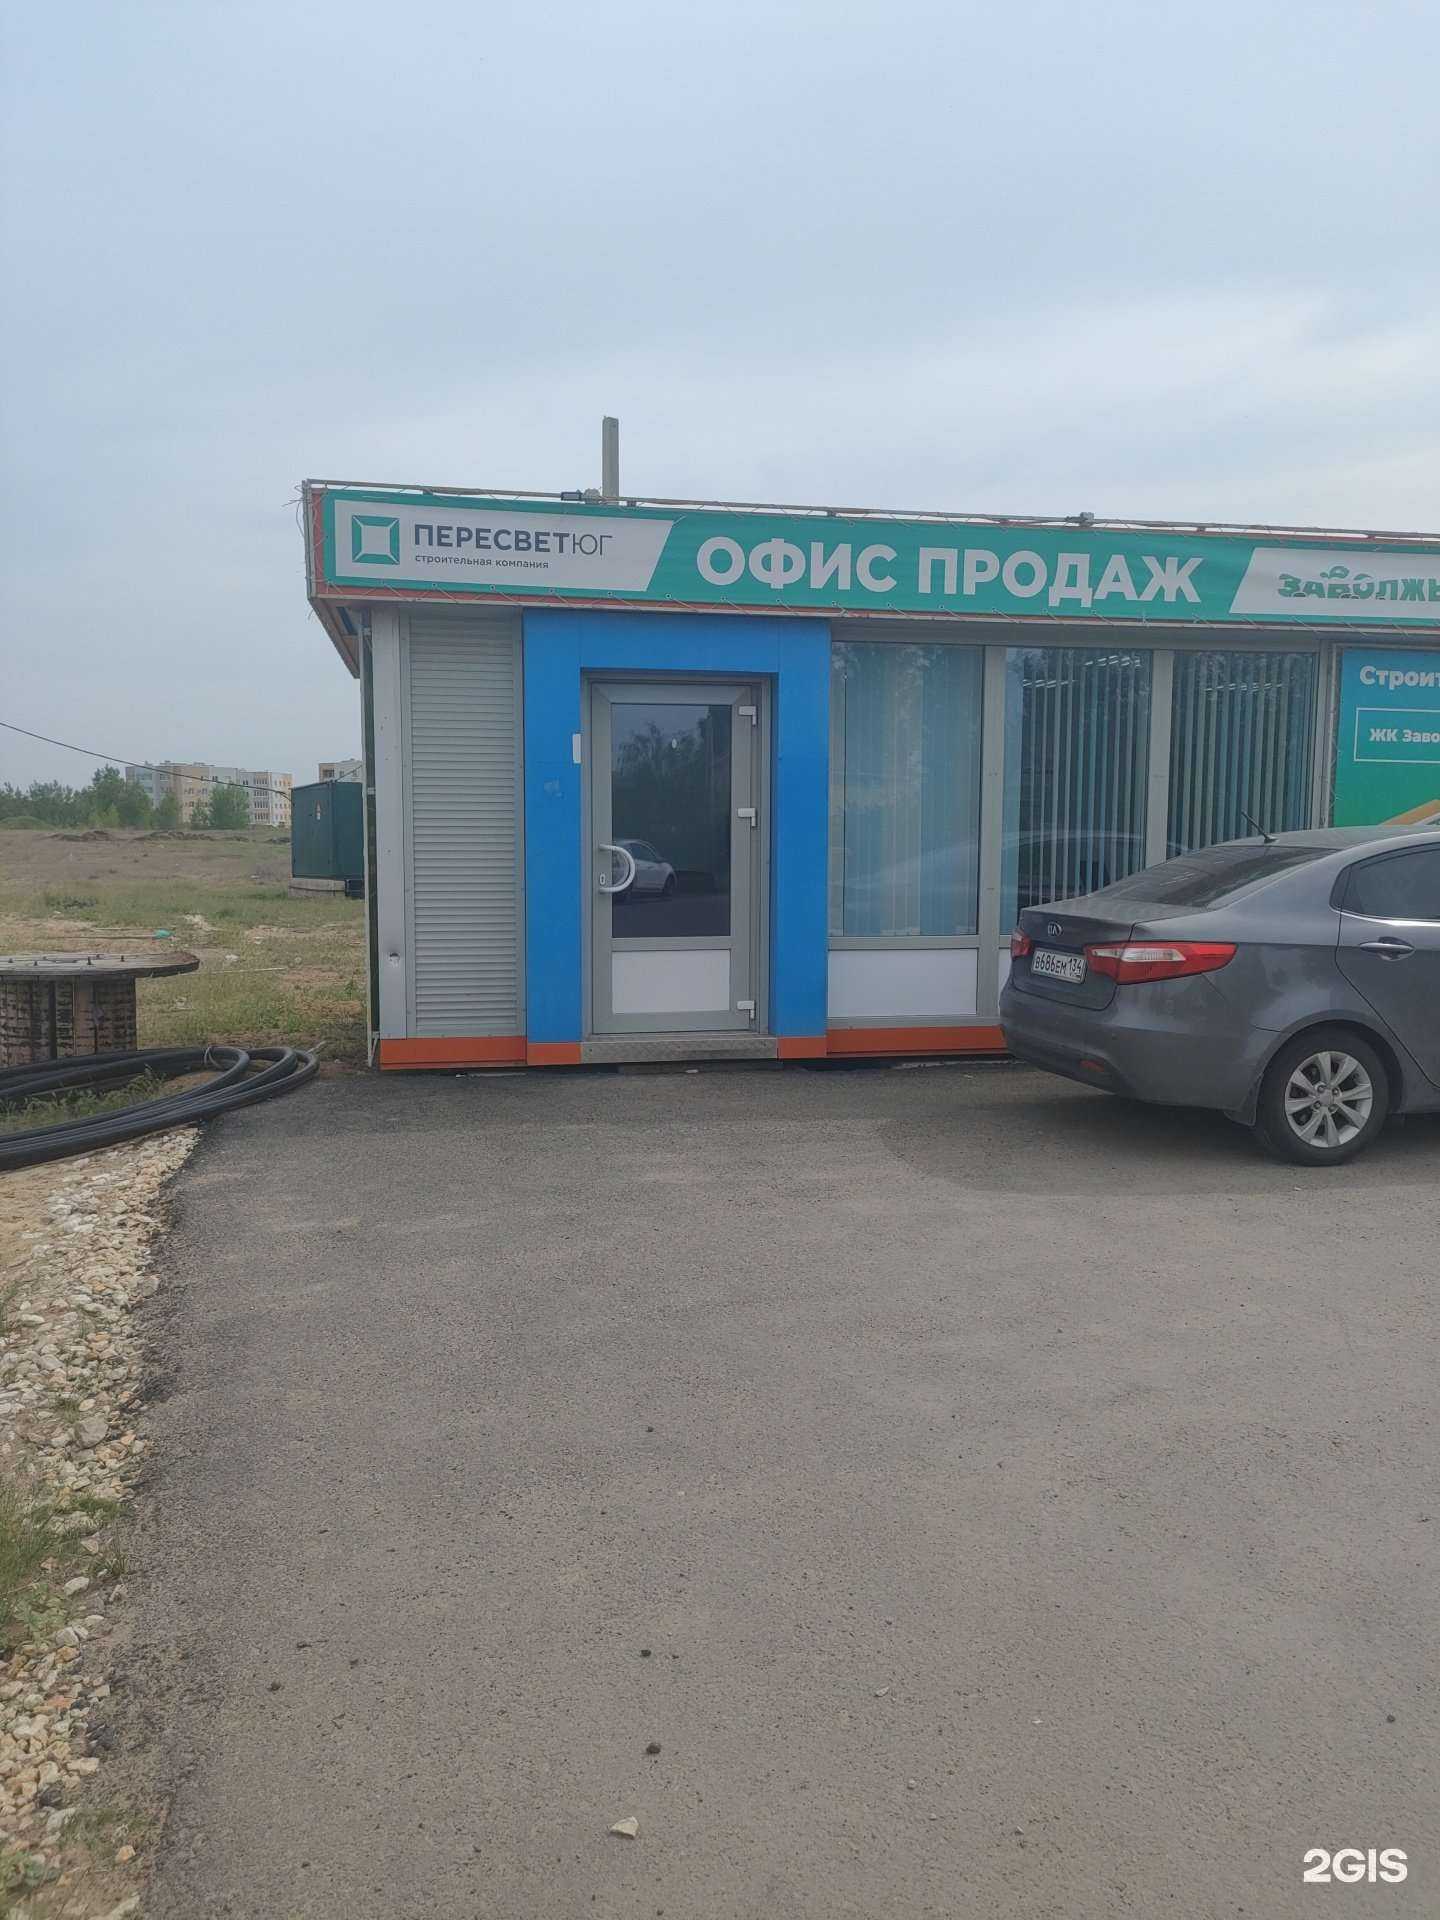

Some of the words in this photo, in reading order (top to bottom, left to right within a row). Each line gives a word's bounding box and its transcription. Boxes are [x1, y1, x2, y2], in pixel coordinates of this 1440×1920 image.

[415, 554, 492, 567] строительная
[495, 558, 549, 569] компания
[696, 536, 898, 593] ОФИС
[918, 546, 1203, 608] ПРОДАЖ
[1369, 728, 1397, 742] ЖК
[1402, 729, 1440, 743] Заво
